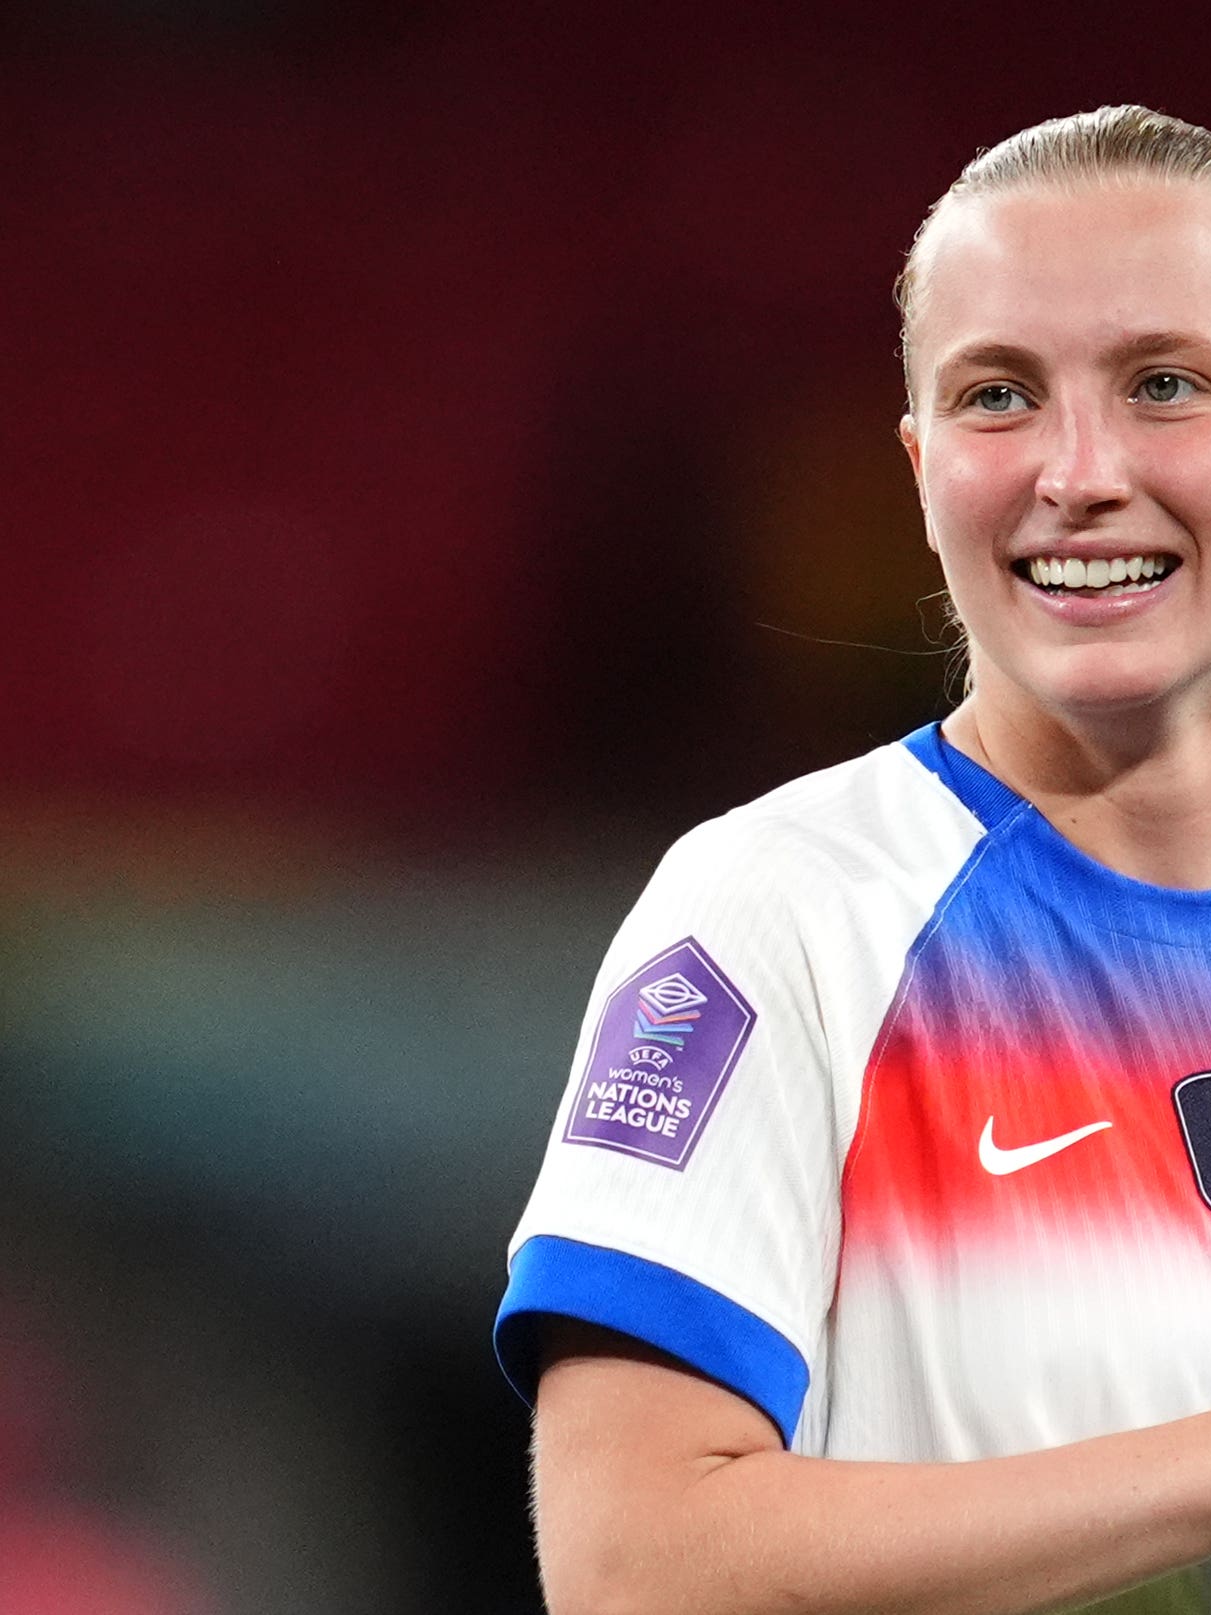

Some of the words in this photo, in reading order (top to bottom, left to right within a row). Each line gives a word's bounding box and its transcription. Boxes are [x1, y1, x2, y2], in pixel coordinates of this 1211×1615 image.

[629, 1050, 670, 1069] UEFA
[608, 1067, 684, 1093] women's
[586, 1081, 692, 1119] NATIONS
[585, 1101, 681, 1138] LEAGUE
